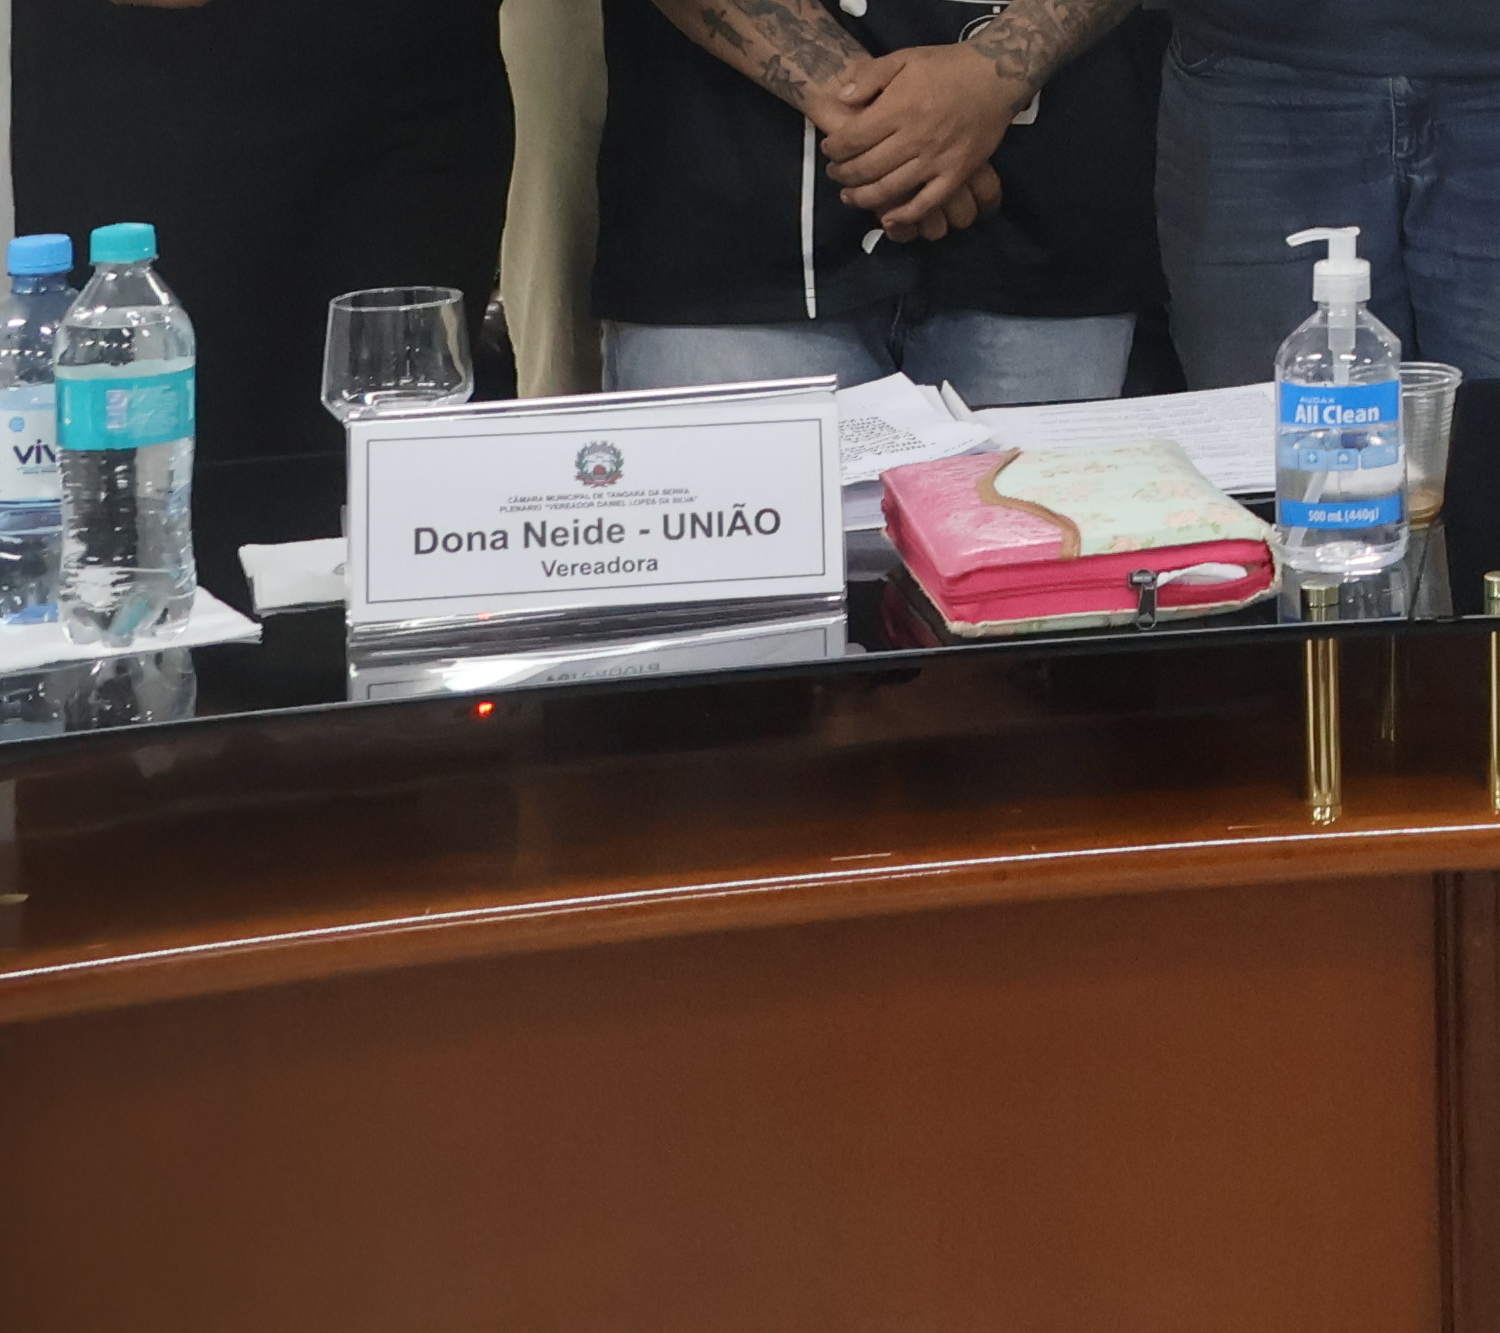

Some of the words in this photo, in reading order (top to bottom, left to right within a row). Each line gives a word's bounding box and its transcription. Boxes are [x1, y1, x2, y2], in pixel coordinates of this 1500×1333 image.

[1295, 405, 1318, 424] All
[1323, 405, 1380, 424] Clean
[1308, 510, 1326, 522] 500
[414, 526, 509, 555] Dona
[523, 516, 625, 549] Neide
[662, 503, 781, 541] UNIÃO
[541, 555, 658, 578] Vereadora
